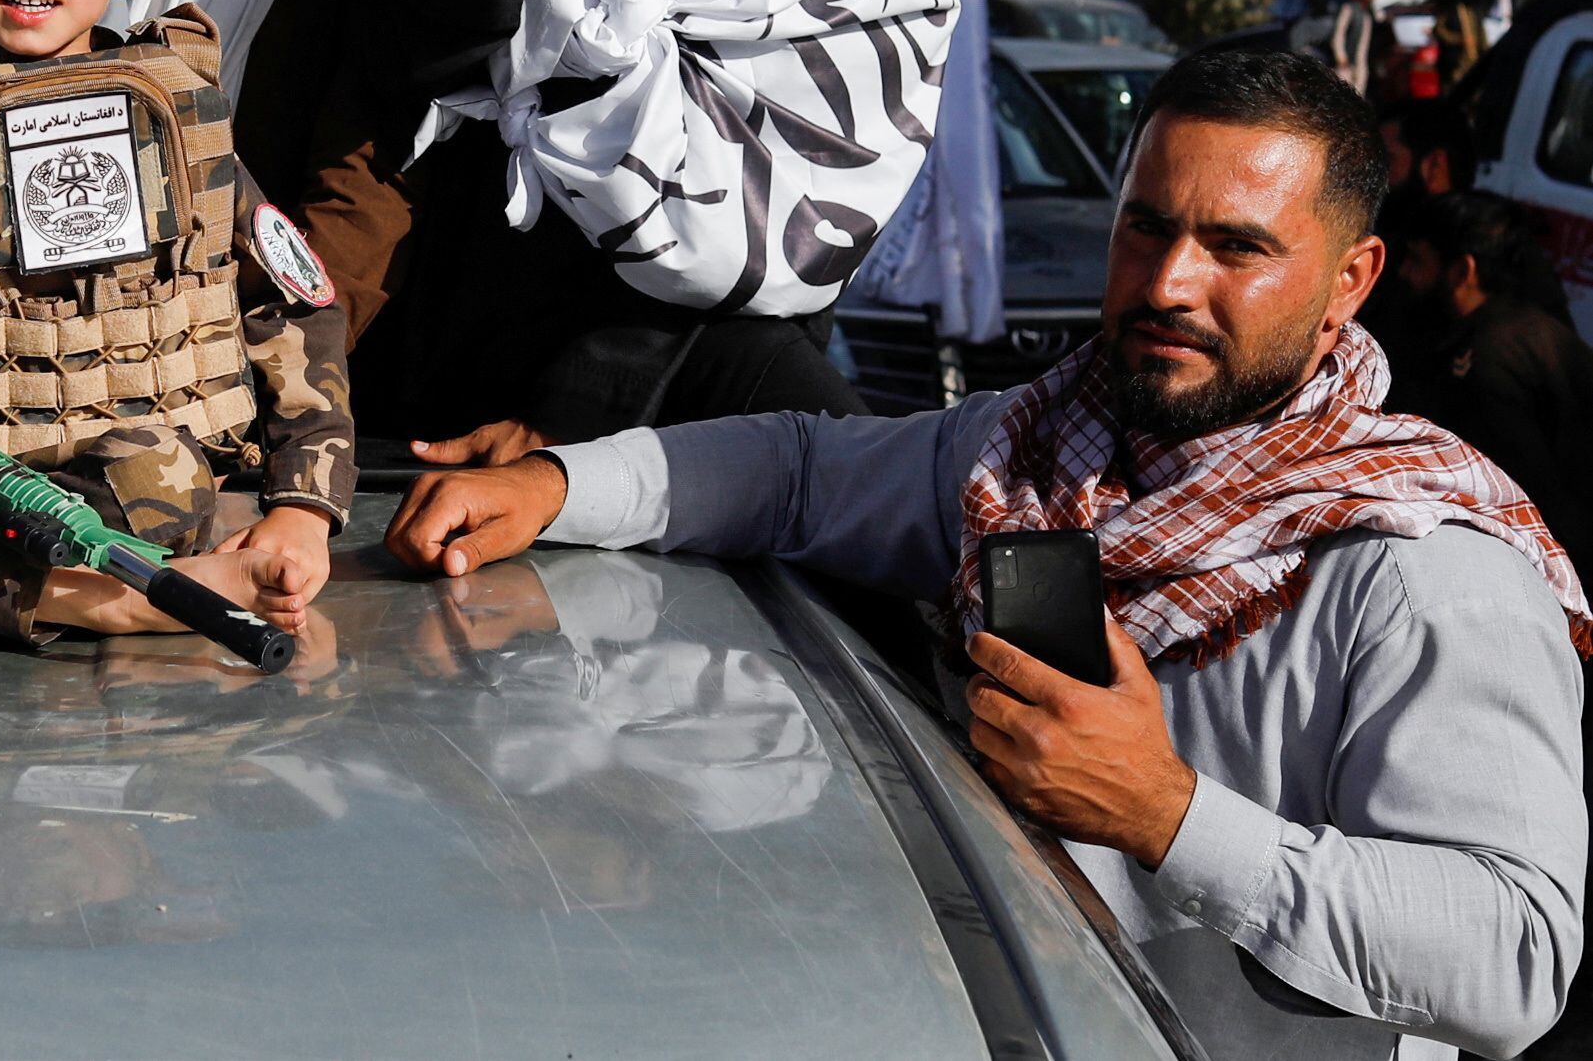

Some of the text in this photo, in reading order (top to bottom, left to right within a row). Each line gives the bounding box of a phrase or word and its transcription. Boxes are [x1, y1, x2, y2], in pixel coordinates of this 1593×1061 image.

[73, 106, 115, 127] افغانستان
[117, 108, 124, 116] د
[10, 117, 37, 135] امارت
